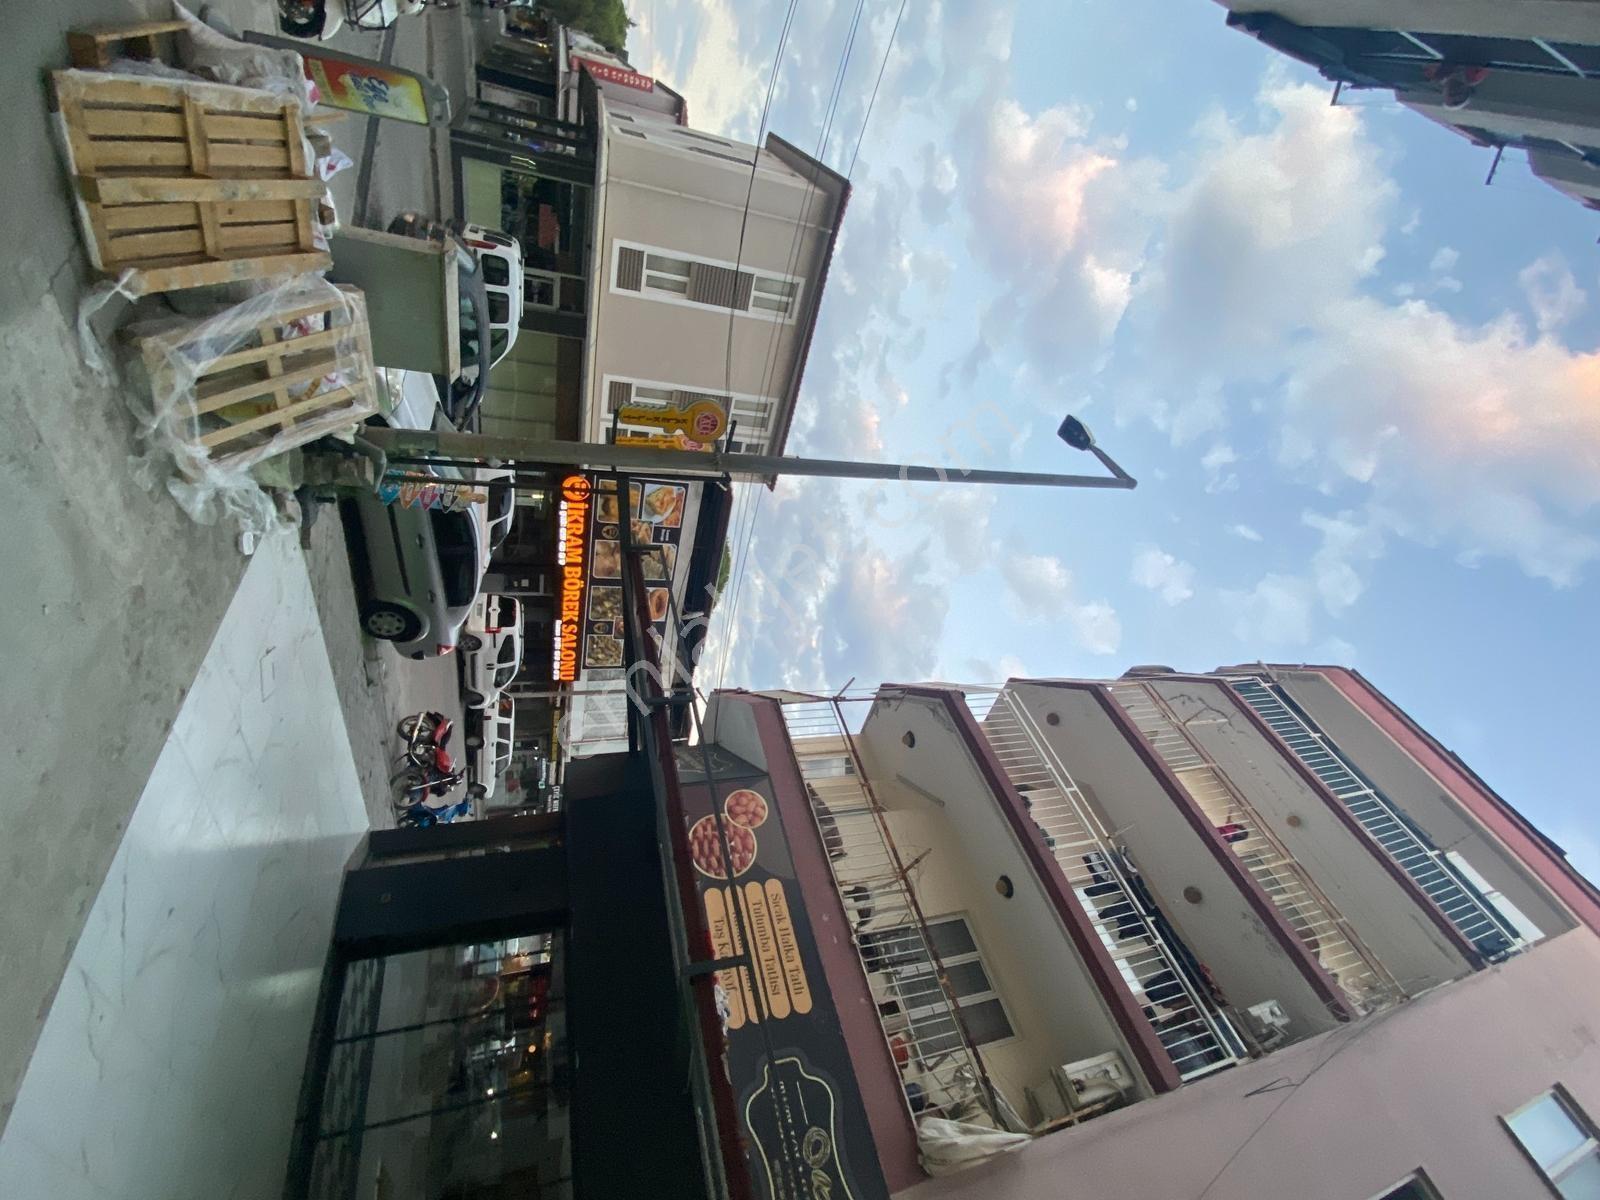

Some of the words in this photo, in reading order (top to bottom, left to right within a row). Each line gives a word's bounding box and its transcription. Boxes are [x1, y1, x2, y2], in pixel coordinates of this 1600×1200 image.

[564, 502, 588, 563] İKRAM
[562, 566, 584, 622] BÖREK
[559, 624, 578, 680] SALONU
[712, 917, 726, 940] Taş
[770, 893, 784, 925] Sıcak
[751, 900, 774, 953] Tulumba
[763, 955, 781, 996] Tatlısı
[776, 928, 796, 963] Halka
[788, 966, 805, 996] Tatlı
